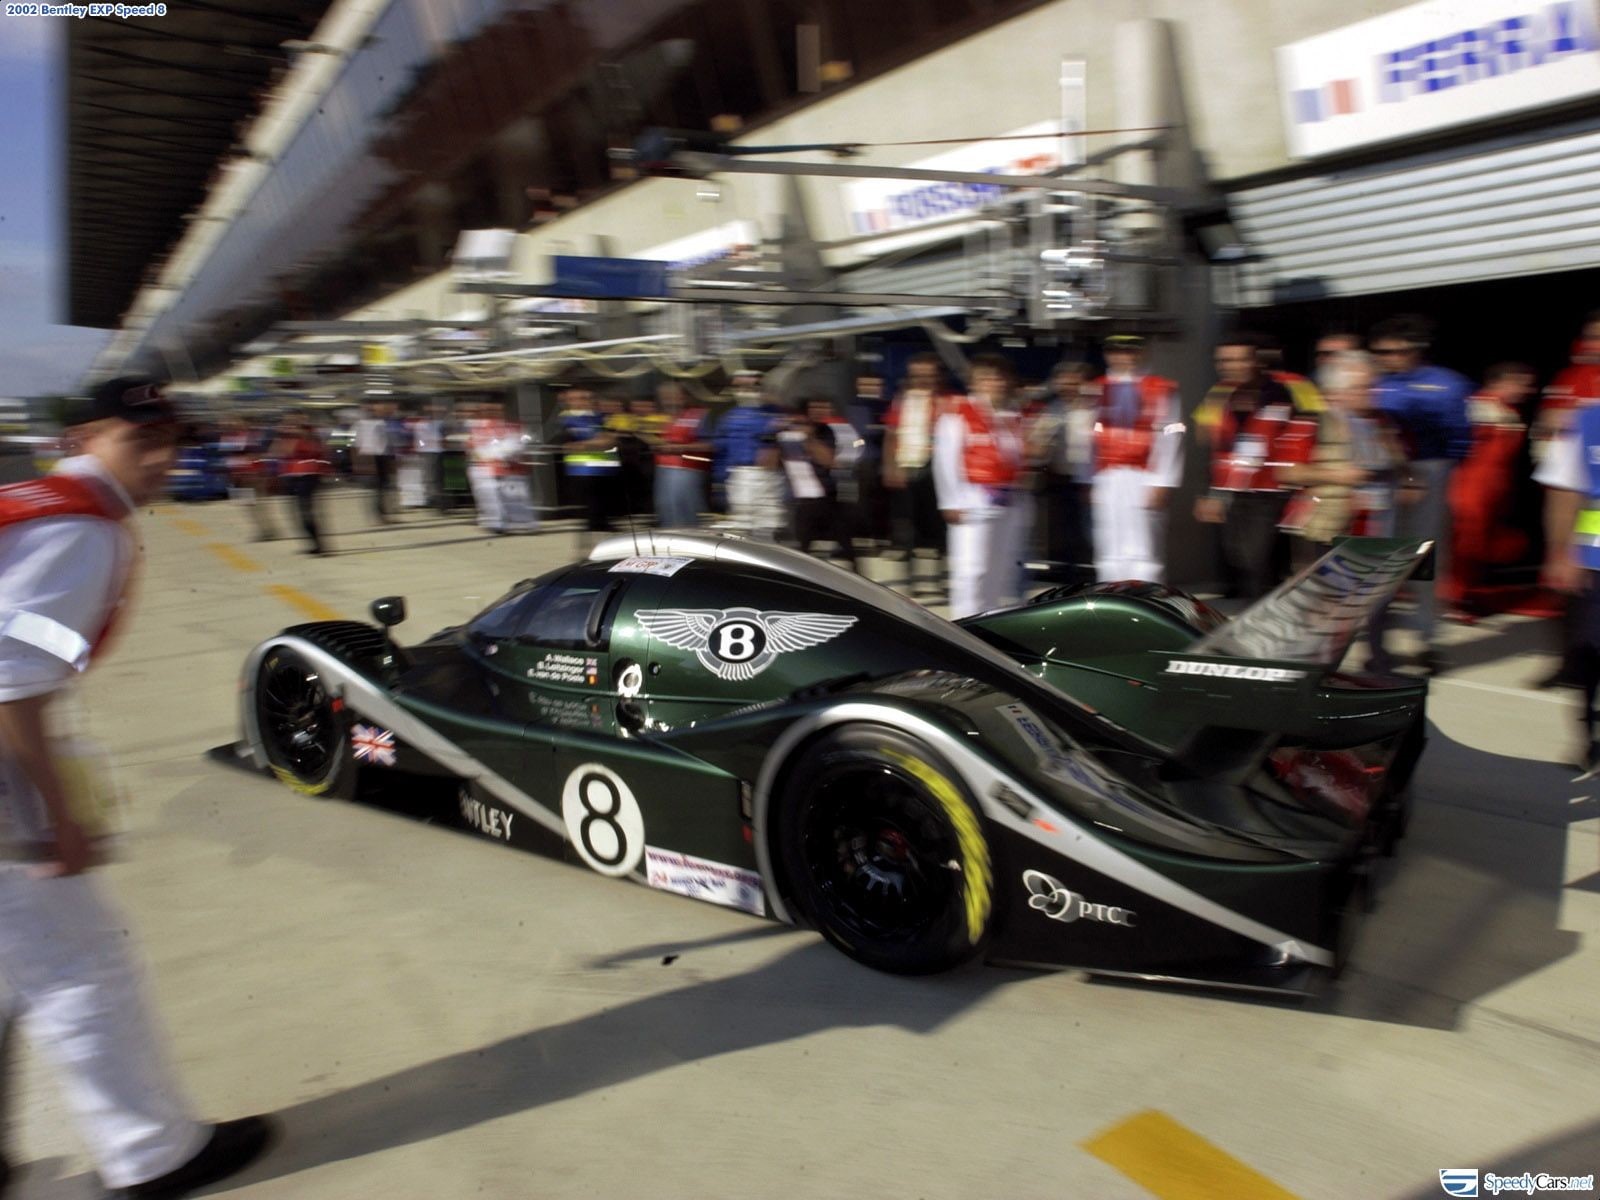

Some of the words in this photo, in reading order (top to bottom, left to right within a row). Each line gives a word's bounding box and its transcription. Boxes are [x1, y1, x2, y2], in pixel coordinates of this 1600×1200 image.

[718, 622, 756, 660] B
[1164, 659, 1304, 683] DUNLOP
[579, 771, 628, 866] 8
[1078, 900, 1123, 925] PTC
